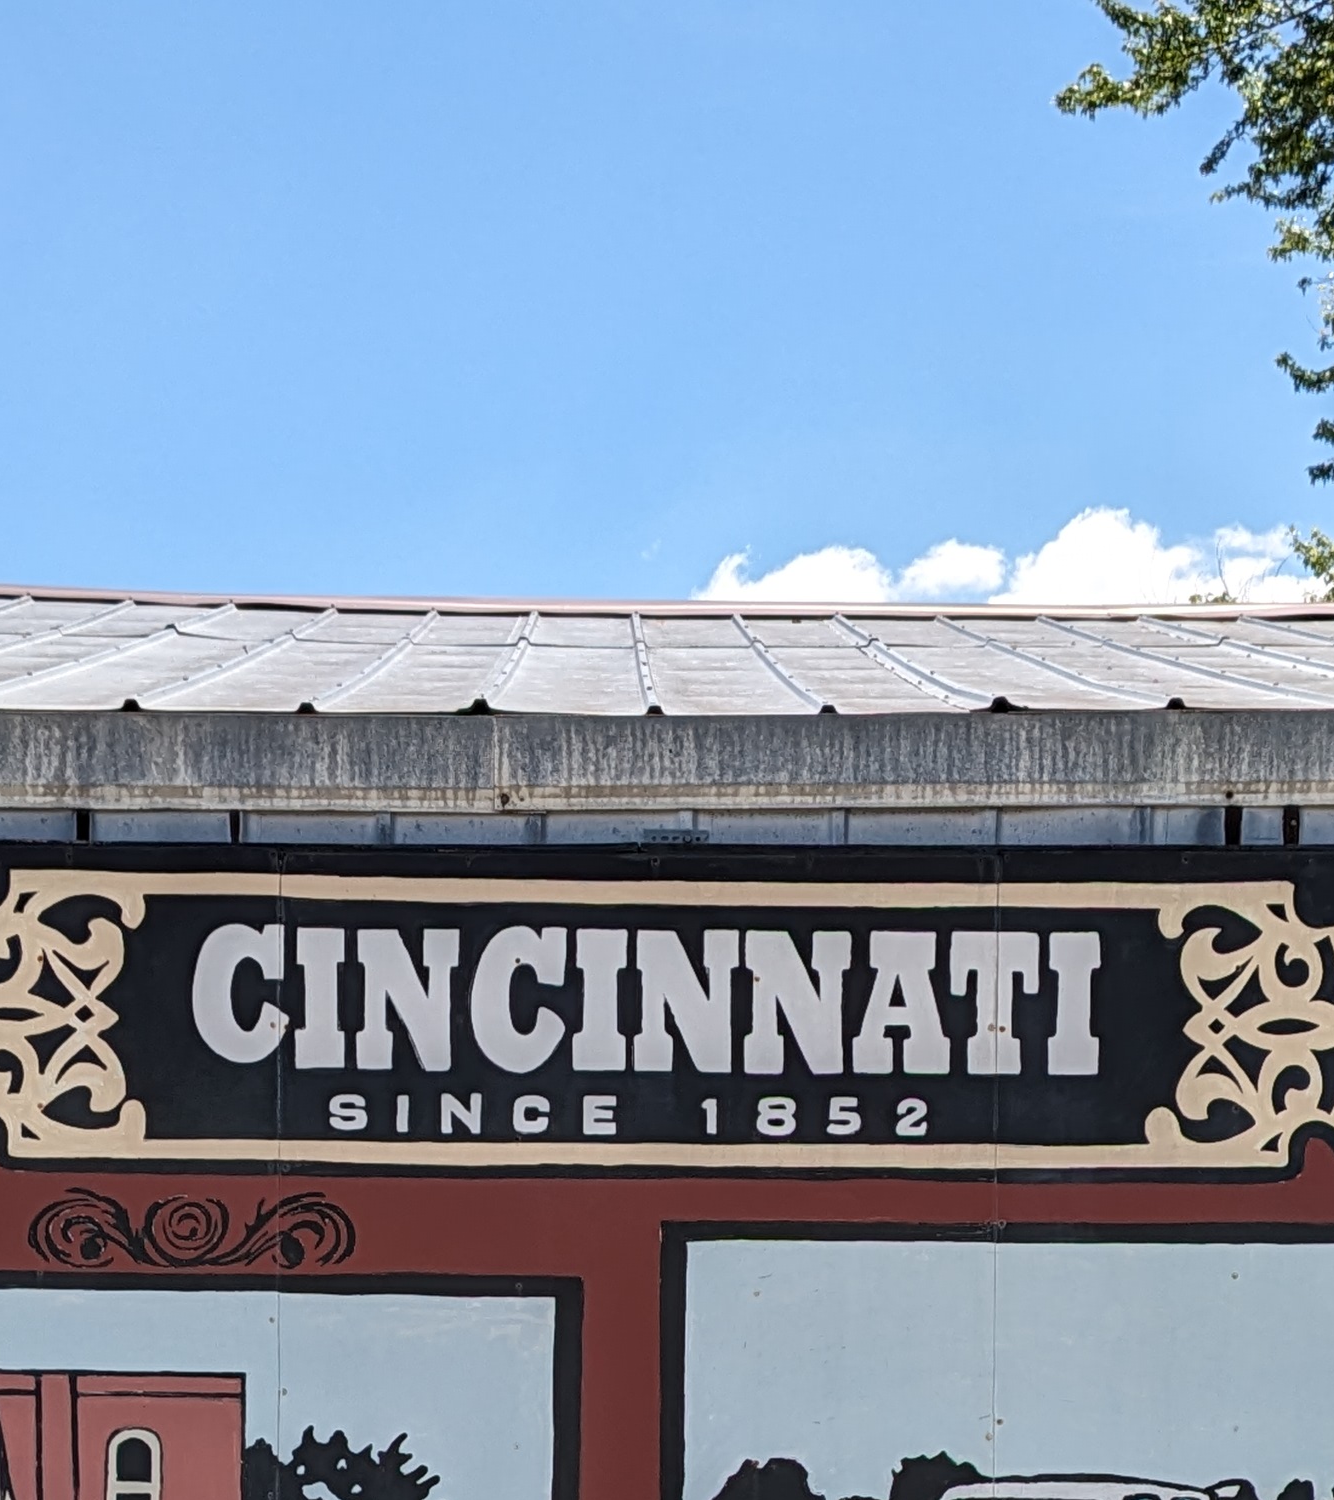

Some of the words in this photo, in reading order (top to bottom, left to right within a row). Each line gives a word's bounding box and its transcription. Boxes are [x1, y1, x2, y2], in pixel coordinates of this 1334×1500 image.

[192, 924, 1100, 1075] CINCINNATI
[329, 1093, 617, 1135] SINCE
[701, 1096, 929, 1136] 1852
